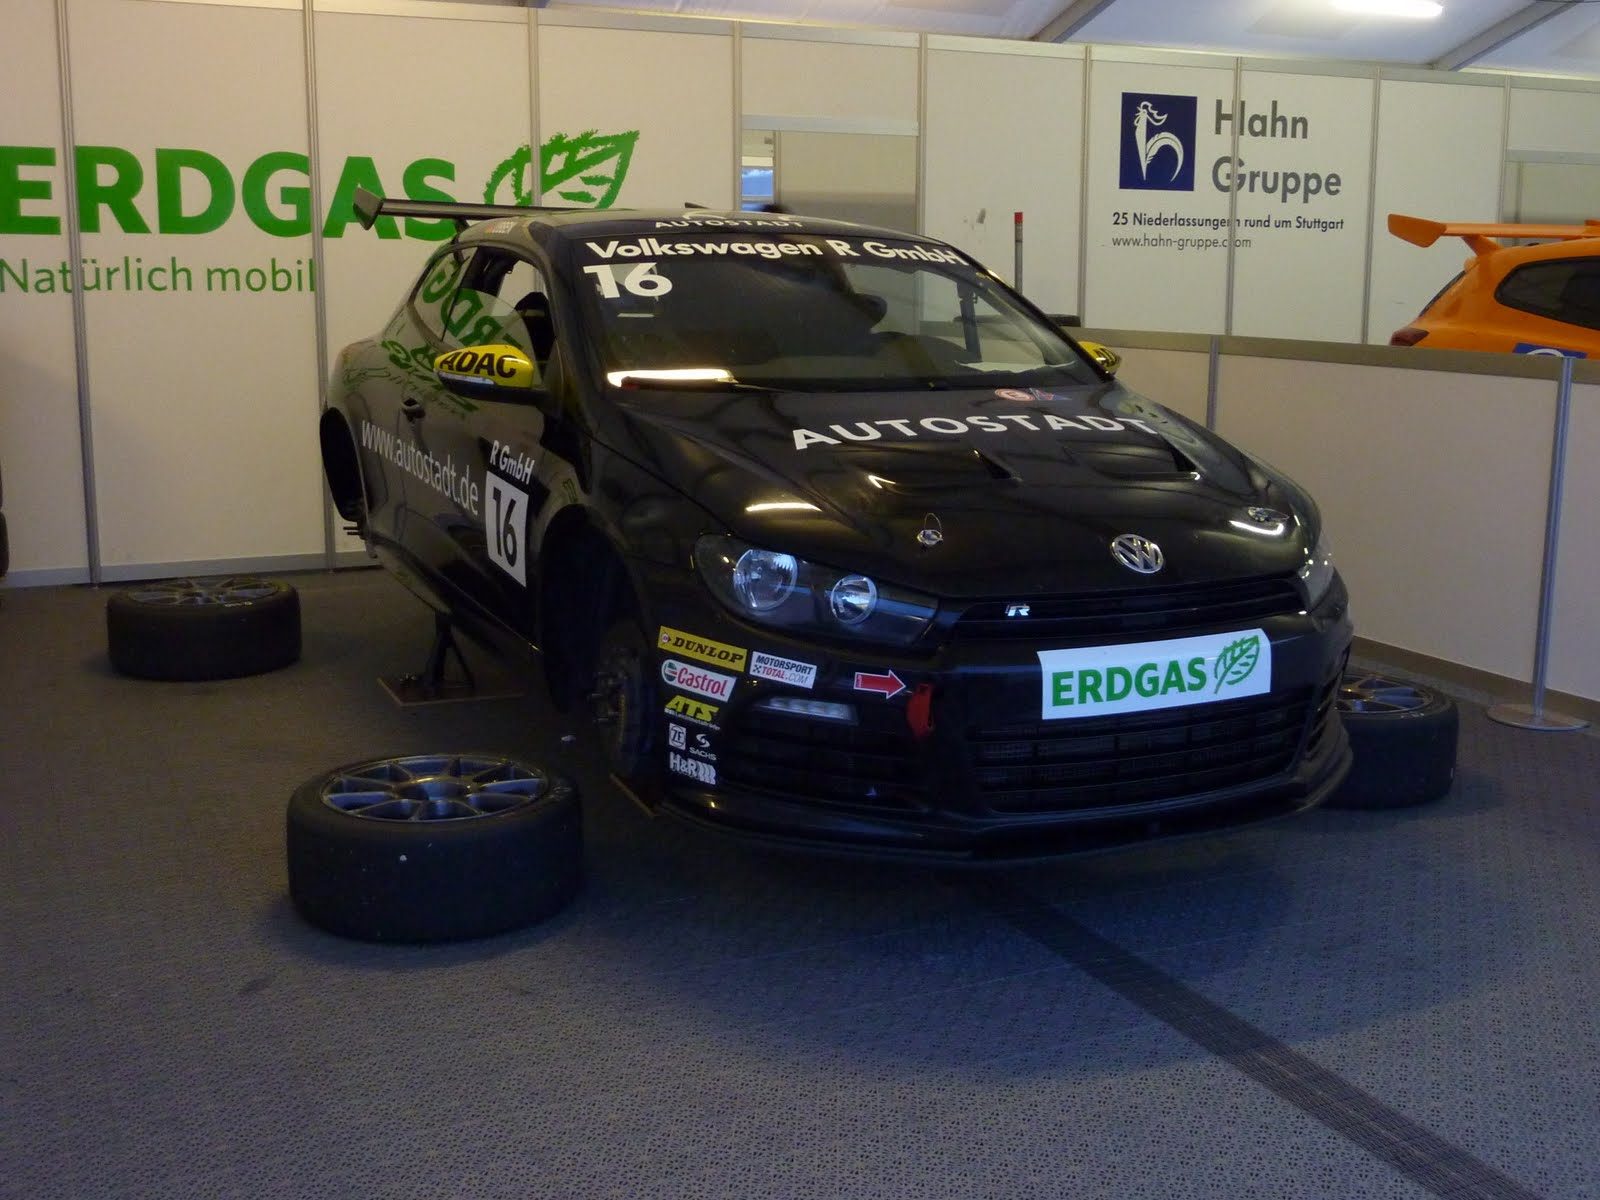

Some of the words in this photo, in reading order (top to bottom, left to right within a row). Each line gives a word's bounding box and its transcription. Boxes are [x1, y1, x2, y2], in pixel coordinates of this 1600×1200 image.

[1214, 98, 1309, 140] Hahn
[0, 145, 458, 242] ERDGAS
[1211, 155, 1343, 204] Gruppe
[655, 219, 803, 229] AUTOSTADT
[1112, 211, 1129, 226] 25
[1132, 212, 1241, 231] Niederlassungen
[1244, 215, 1271, 229] rund
[1274, 218, 1293, 230] um
[1295, 216, 1345, 233] Stuttgart
[585, 237, 823, 260] Volkswagen
[825, 239, 861, 258] R
[862, 241, 970, 267] GmbH
[1111, 232, 1252, 251] www.hahn-gruppe.com
[0, 255, 193, 294] Natürlich
[206, 257, 316, 293] mobil
[582, 262, 673, 300] 16
[438, 349, 517, 379] ADAC
[792, 413, 1159, 451] AUTOSTADT
[361, 419, 479, 516] www.autostadt.de
[489, 439, 499, 465] R
[499, 444, 536, 486] GmbH
[492, 485, 518, 569] 16
[672, 635, 744, 664] DUNLOP
[755, 654, 814, 676] MOTORSPORT
[676, 666, 728, 698] Castrol
[1051, 656, 1208, 708] ERDGAS
[664, 694, 720, 722] ATS
[689, 746, 718, 761] SACHS
